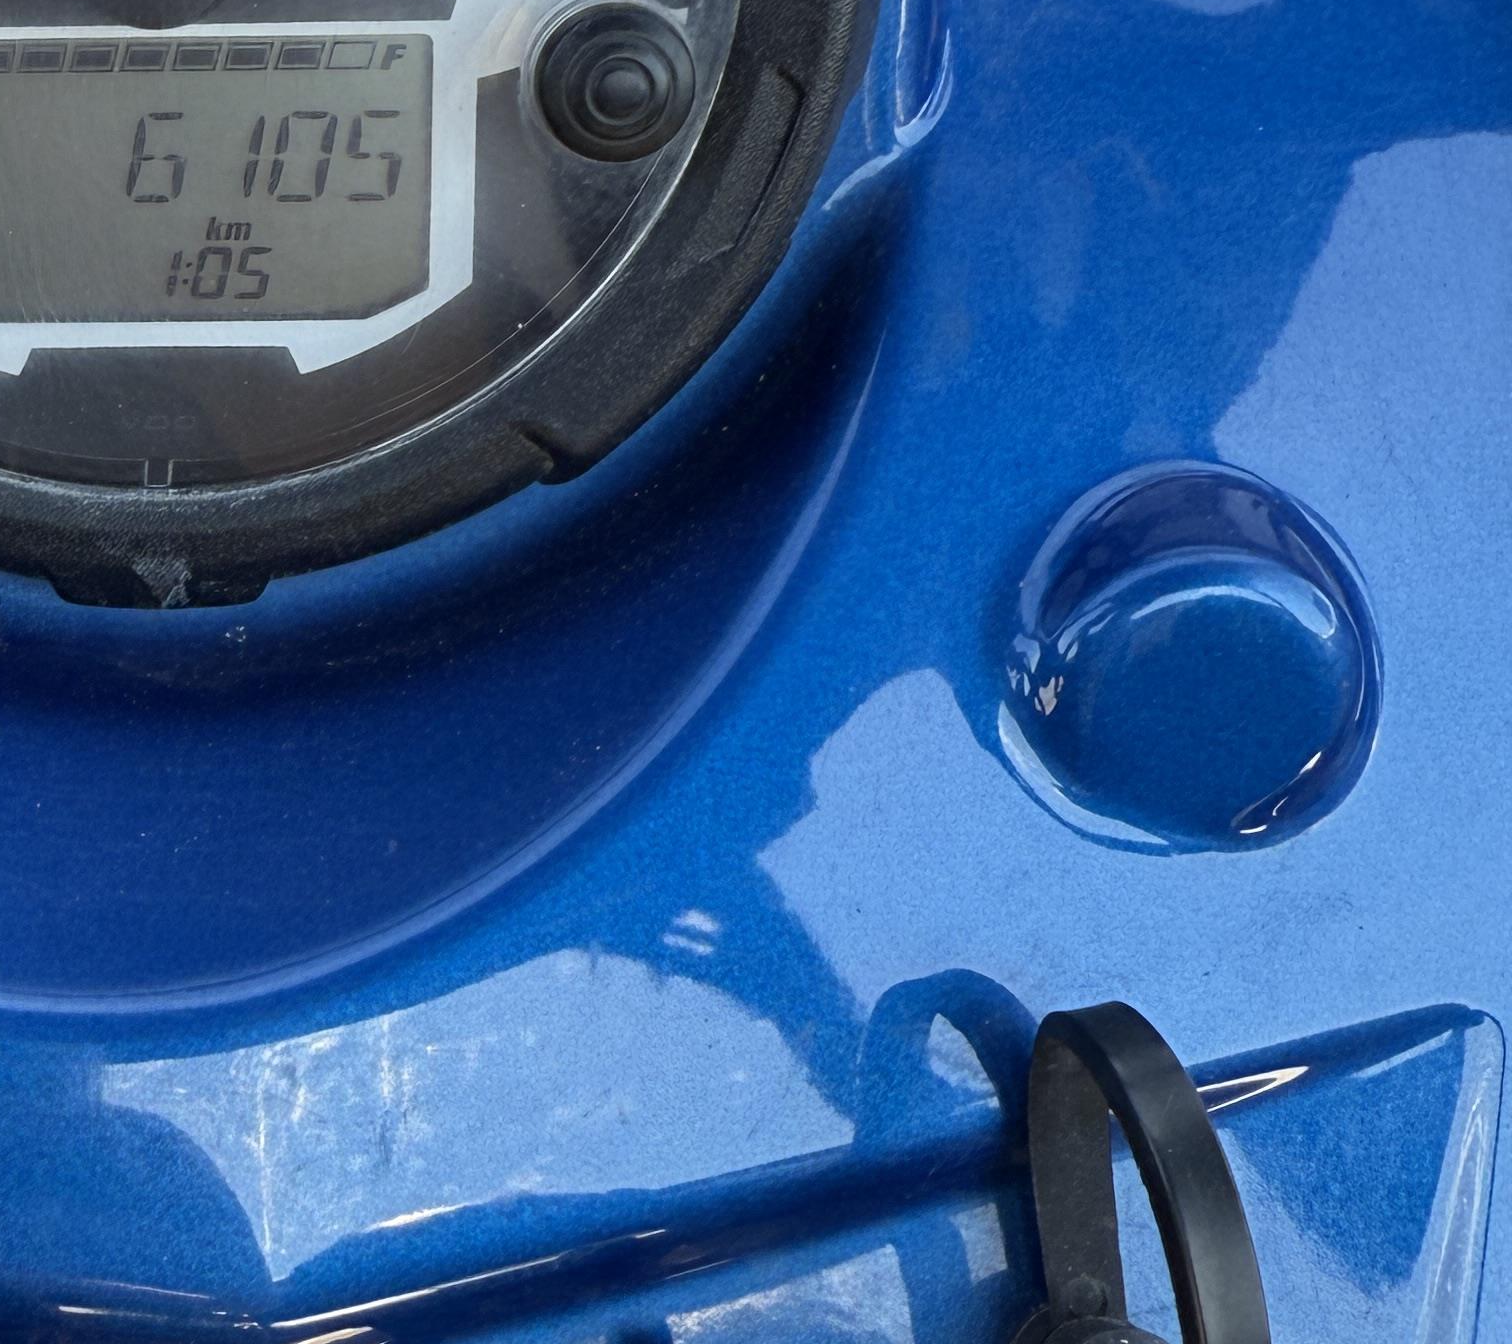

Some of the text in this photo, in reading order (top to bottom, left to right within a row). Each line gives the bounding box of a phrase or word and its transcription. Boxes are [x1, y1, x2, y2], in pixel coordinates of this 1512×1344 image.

[381, 44, 407, 69] F
[125, 110, 401, 203] 6105
[206, 216, 252, 242] km
[166, 246, 272, 300] 1:05
